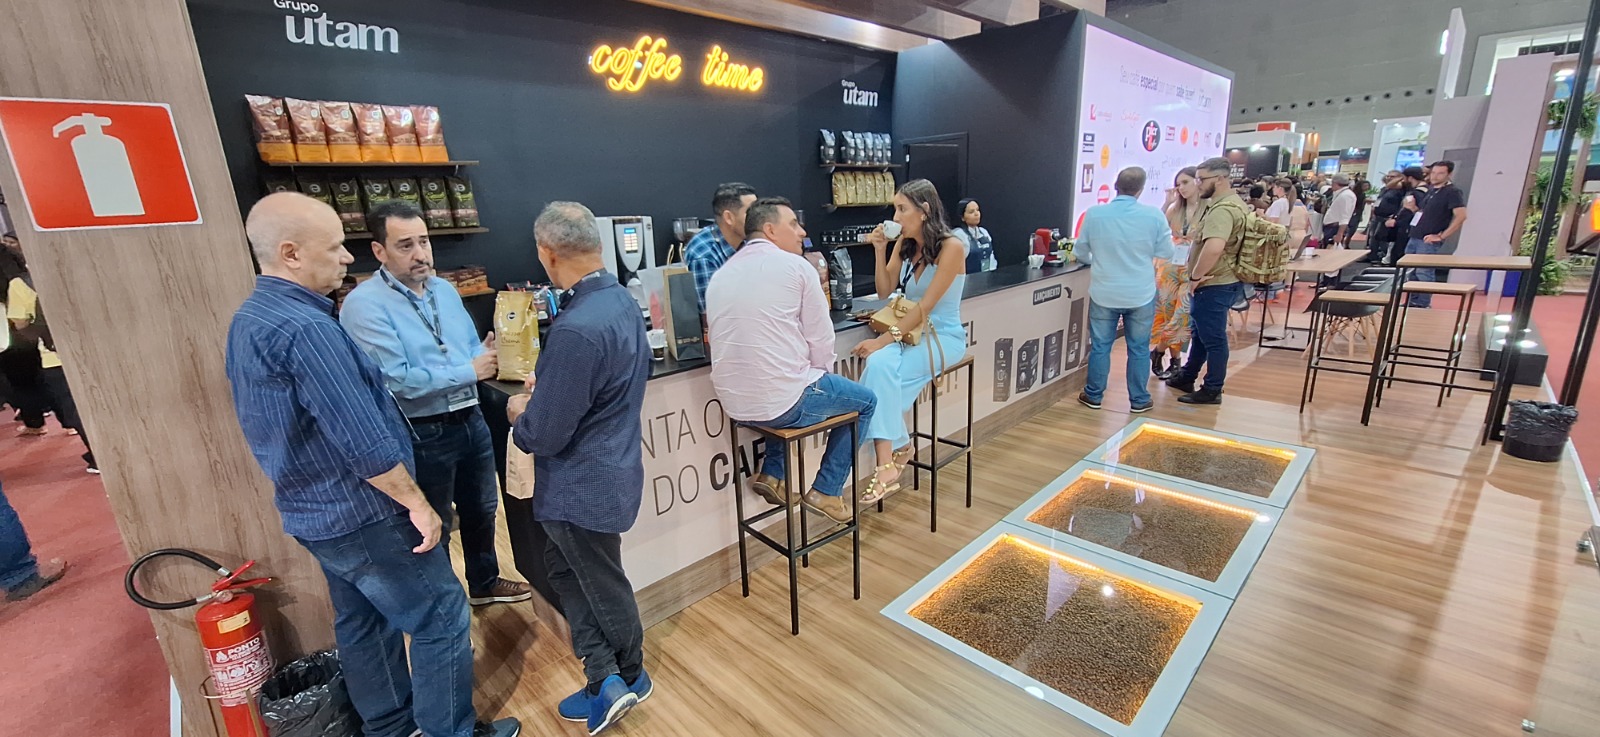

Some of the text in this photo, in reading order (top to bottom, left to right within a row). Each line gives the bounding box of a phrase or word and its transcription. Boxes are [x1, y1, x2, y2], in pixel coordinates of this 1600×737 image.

[273, 0, 319, 13] Grupo
[286, 13, 399, 53] utam
[590, 36, 764, 92] coffee time
[843, 86, 878, 107] utam
[1034, 287, 1061, 302] LANÇAMENTO
[641, 408, 696, 459] NTA
[652, 464, 700, 517] DO
[709, 436, 766, 492] CAF
[227, 637, 261, 655] PONTO
